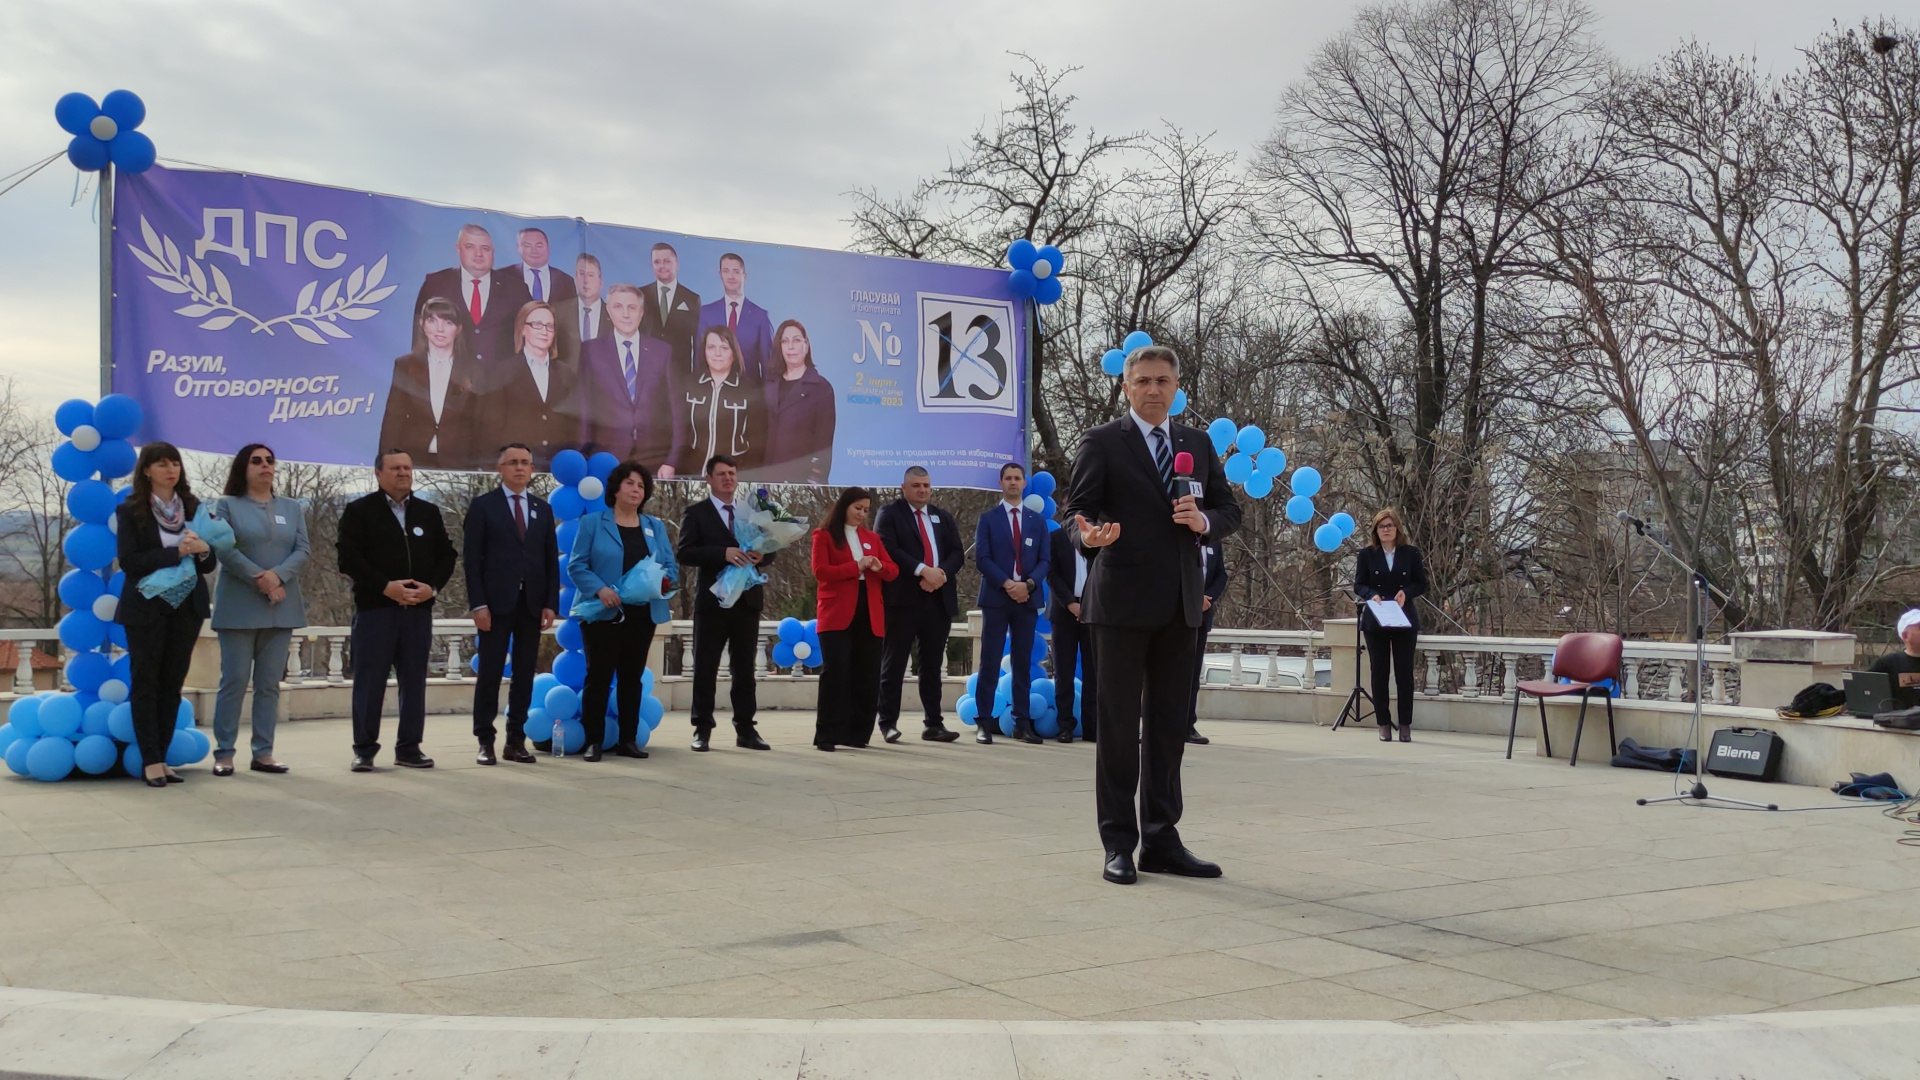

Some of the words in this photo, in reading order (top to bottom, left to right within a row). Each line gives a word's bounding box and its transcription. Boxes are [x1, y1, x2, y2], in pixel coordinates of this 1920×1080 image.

[194, 207, 348, 270] ДПС
[850, 289, 901, 306] ГЛАСУВАЙ
[928, 311, 1007, 401] 13
[855, 371, 864, 386] 2
[881, 396, 904, 407] 2023
[902, 448, 955, 458] продаването
[956, 449, 967, 457] на
[937, 459, 947, 467] се
[1191, 484, 1201, 495] 13
[1716, 744, 1760, 760] Biema
